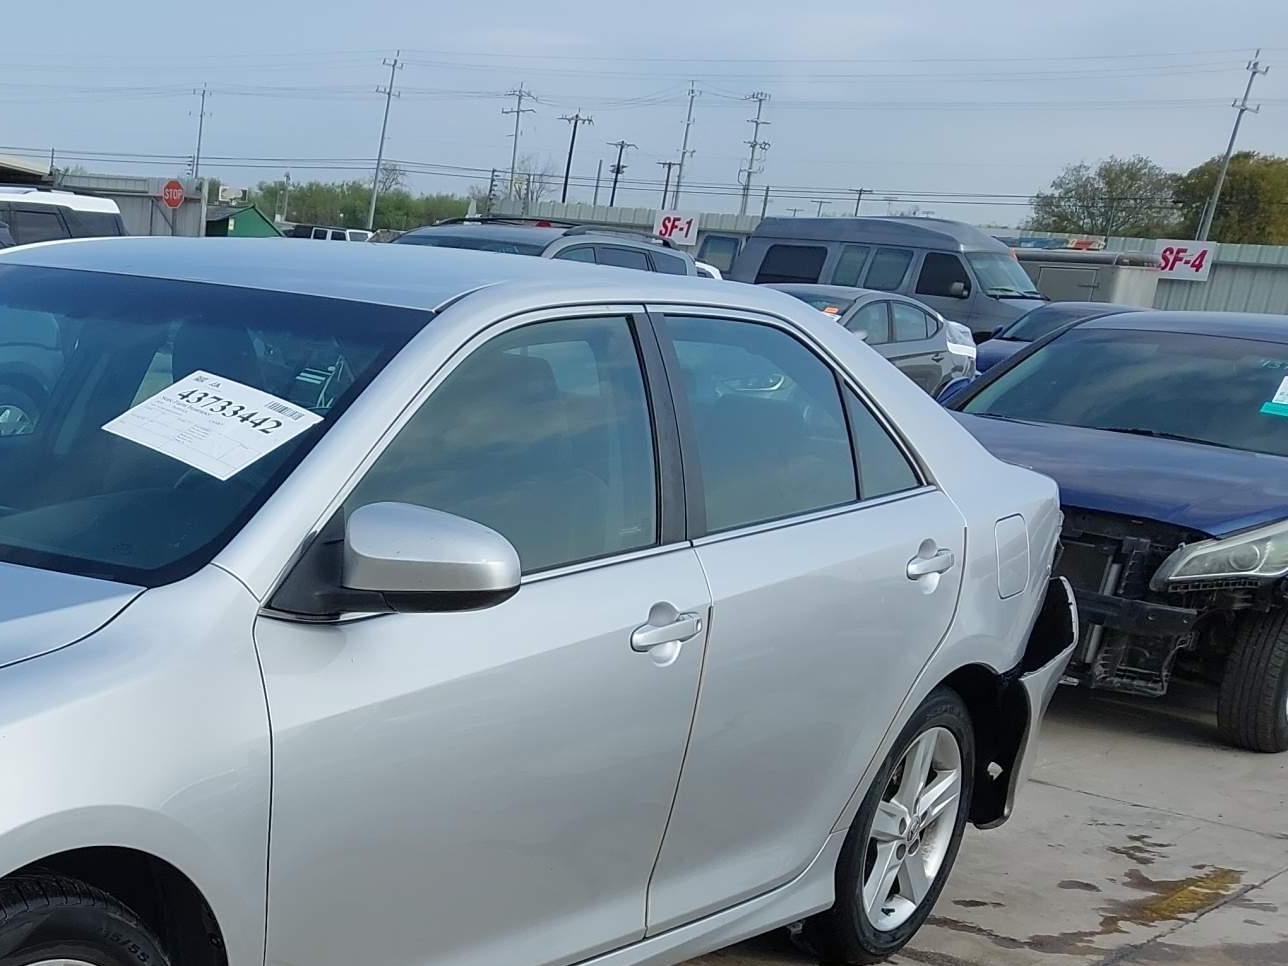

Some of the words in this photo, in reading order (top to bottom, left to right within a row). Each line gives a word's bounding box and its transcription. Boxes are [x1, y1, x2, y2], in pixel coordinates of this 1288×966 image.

[164, 188, 183, 200] STOP
[659, 216, 694, 238] SF-1
[1159, 246, 1208, 273] SF-4
[178, 389, 282, 434] 43733442
